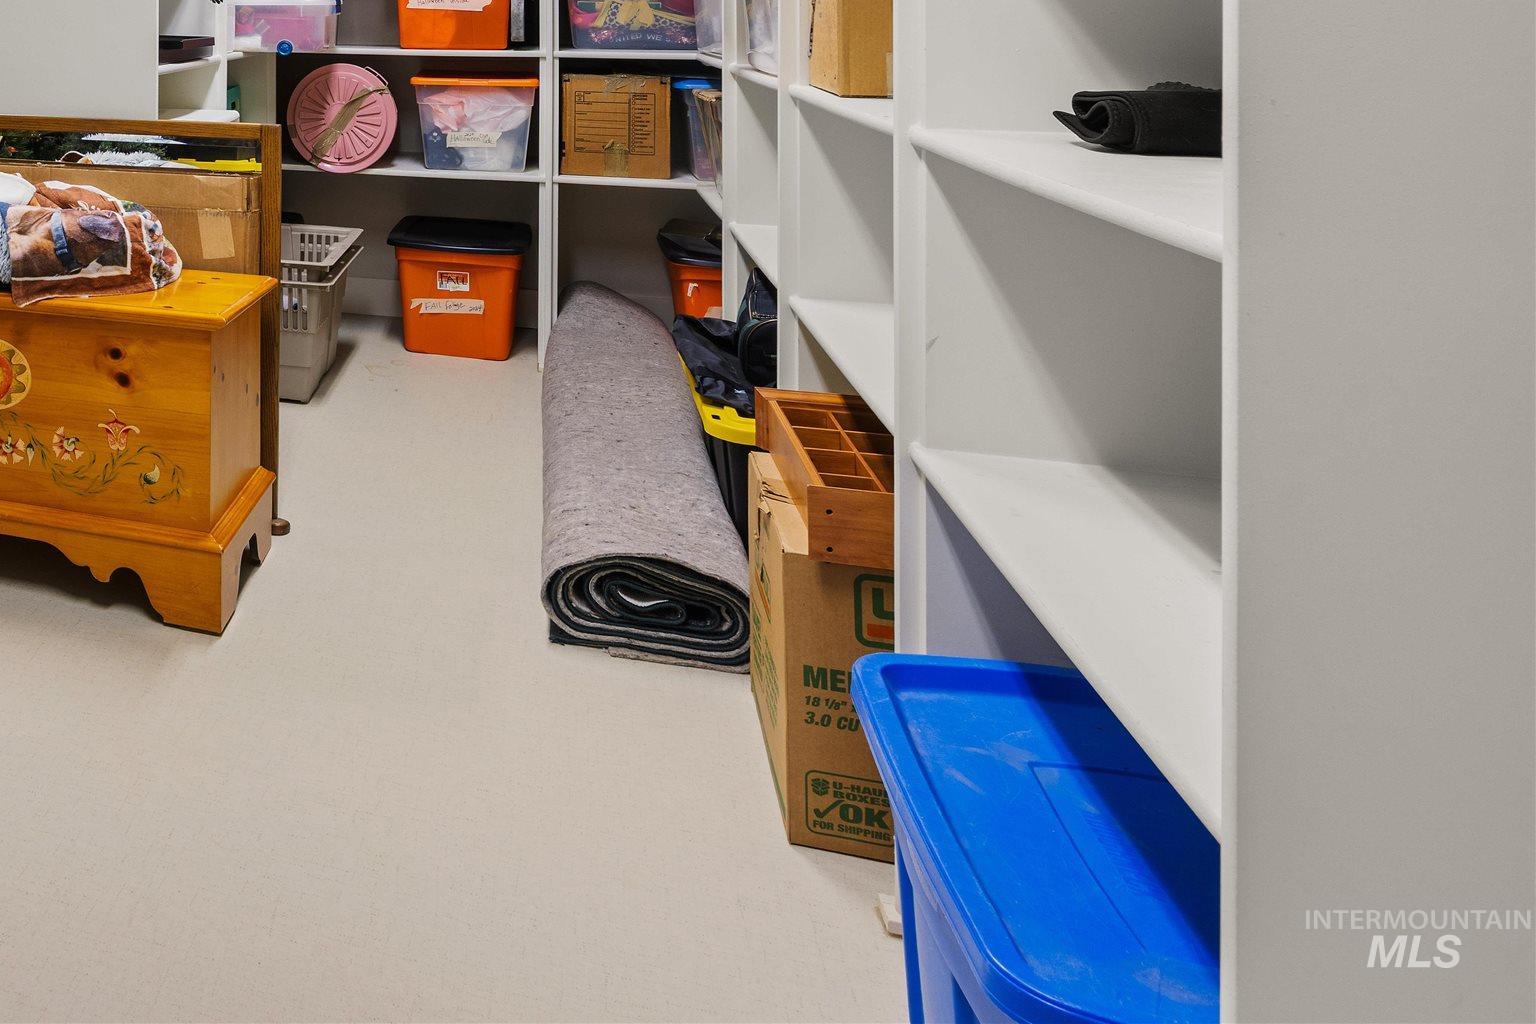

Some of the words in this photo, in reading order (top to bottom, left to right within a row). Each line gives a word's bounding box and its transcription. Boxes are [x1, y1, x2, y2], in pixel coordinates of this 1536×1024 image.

[646, 33, 663, 41] WE
[805, 695, 821, 707] 18
[804, 711, 832, 727] 3.0
[837, 716, 860, 732] CU
[839, 803, 890, 830] OK
[813, 819, 834, 831] FOR
[837, 823, 891, 841] SHIPPING
